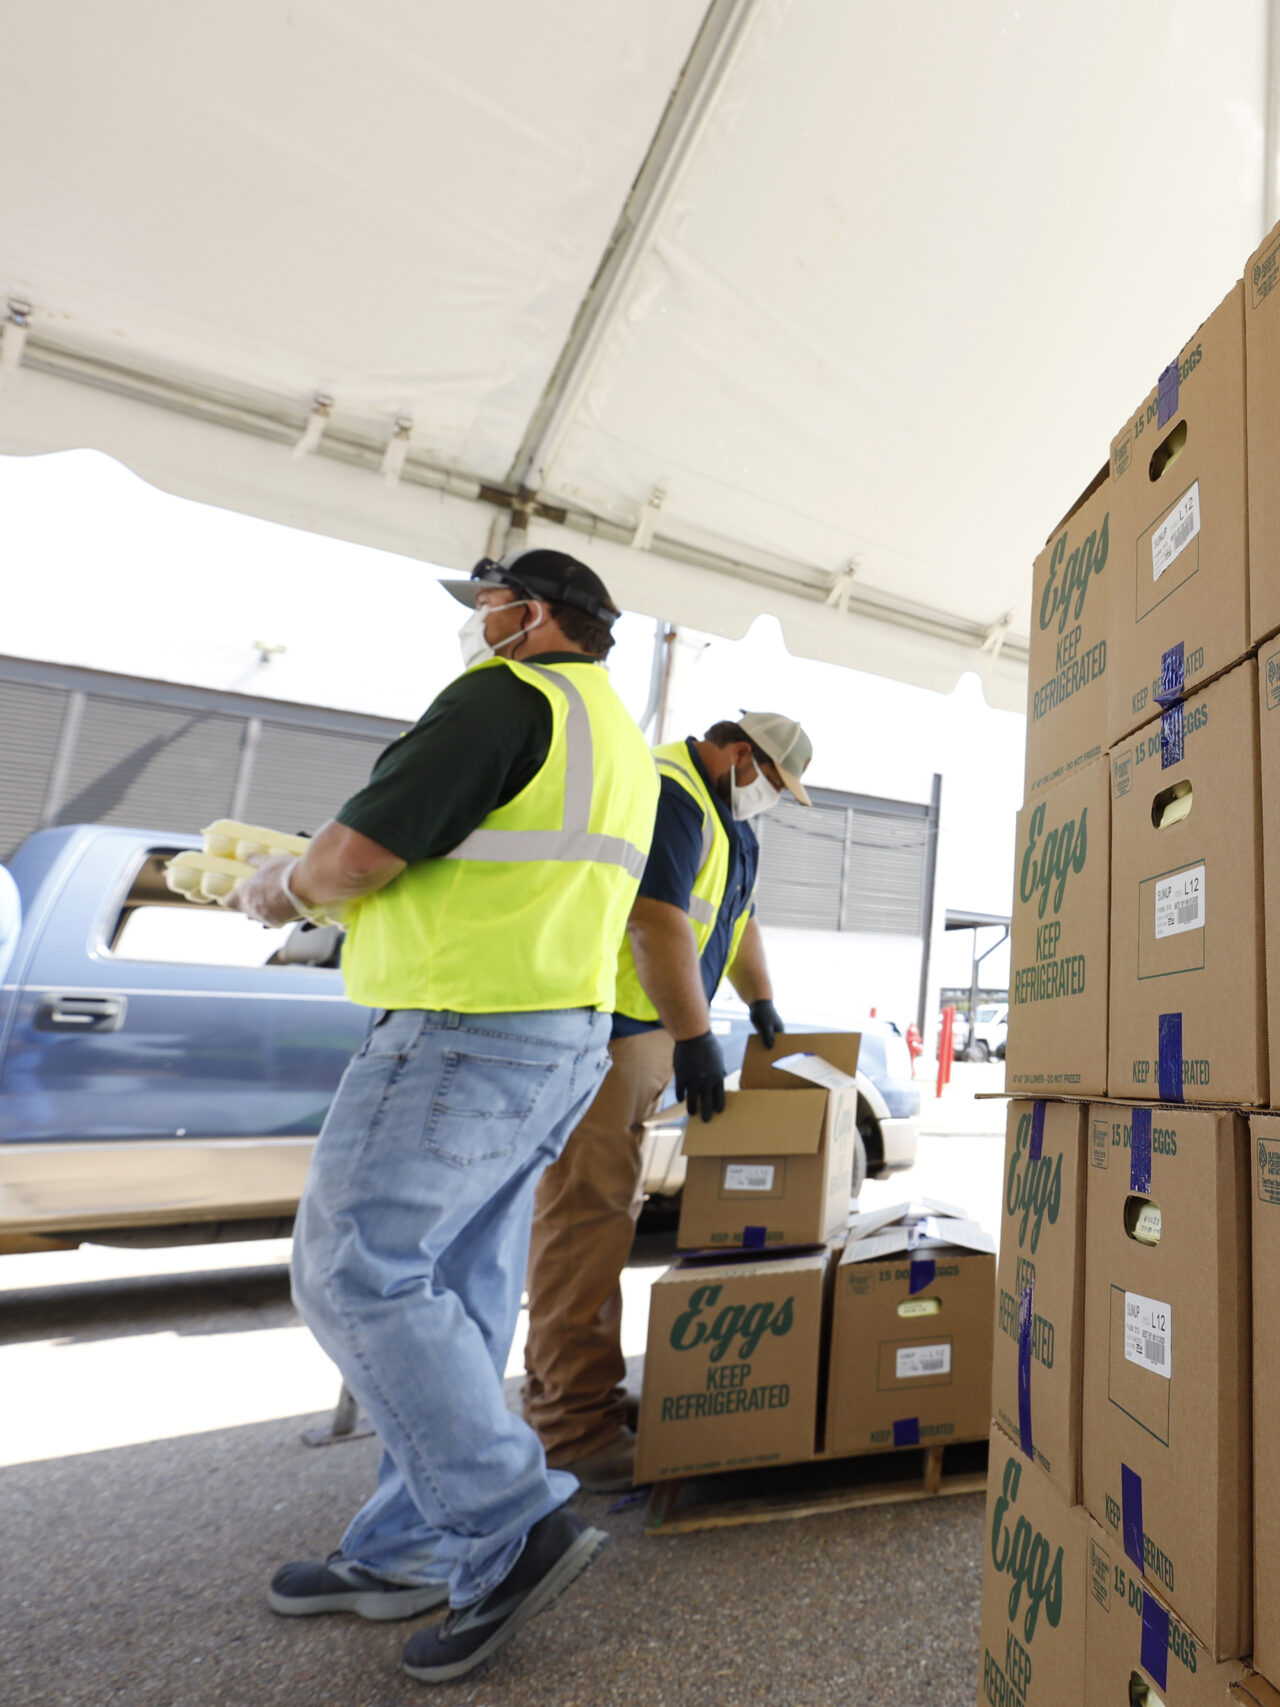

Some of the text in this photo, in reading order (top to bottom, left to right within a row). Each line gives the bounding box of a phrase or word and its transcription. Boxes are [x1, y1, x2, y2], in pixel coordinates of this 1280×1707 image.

[1134, 413, 1145, 440] 15
[1039, 511, 1110, 635] Eggs
[1055, 624, 1082, 672] KEEP
[1033, 639, 1107, 722] REFRIGERATED
[1132, 686, 1148, 715] KEEP
[1135, 742, 1146, 765] 15
[1182, 703, 1208, 738] EGGS
[1020, 801, 1088, 921] Eggs
[1184, 877, 1199, 895] L12
[1036, 920, 1061, 963] KEEP
[1014, 954, 1086, 1004] REFRIGERATED
[1133, 1060, 1149, 1083] KEEP
[1111, 1123, 1121, 1146] 15
[1152, 1128, 1178, 1157] EGGS
[1006, 1113, 1064, 1255] Eggs
[669, 1284, 795, 1363] Eggs
[1151, 1312, 1166, 1332] L12
[706, 1363, 752, 1391] KEEP
[661, 1384, 790, 1422] REFRIGERATED
[1105, 1493, 1121, 1531] KEEP
[992, 1457, 1064, 1645] Eggs
[1114, 1565, 1126, 1598] 15
[1167, 1618, 1197, 1674] EGGS
[1005, 1627, 1032, 1702] KEEP
